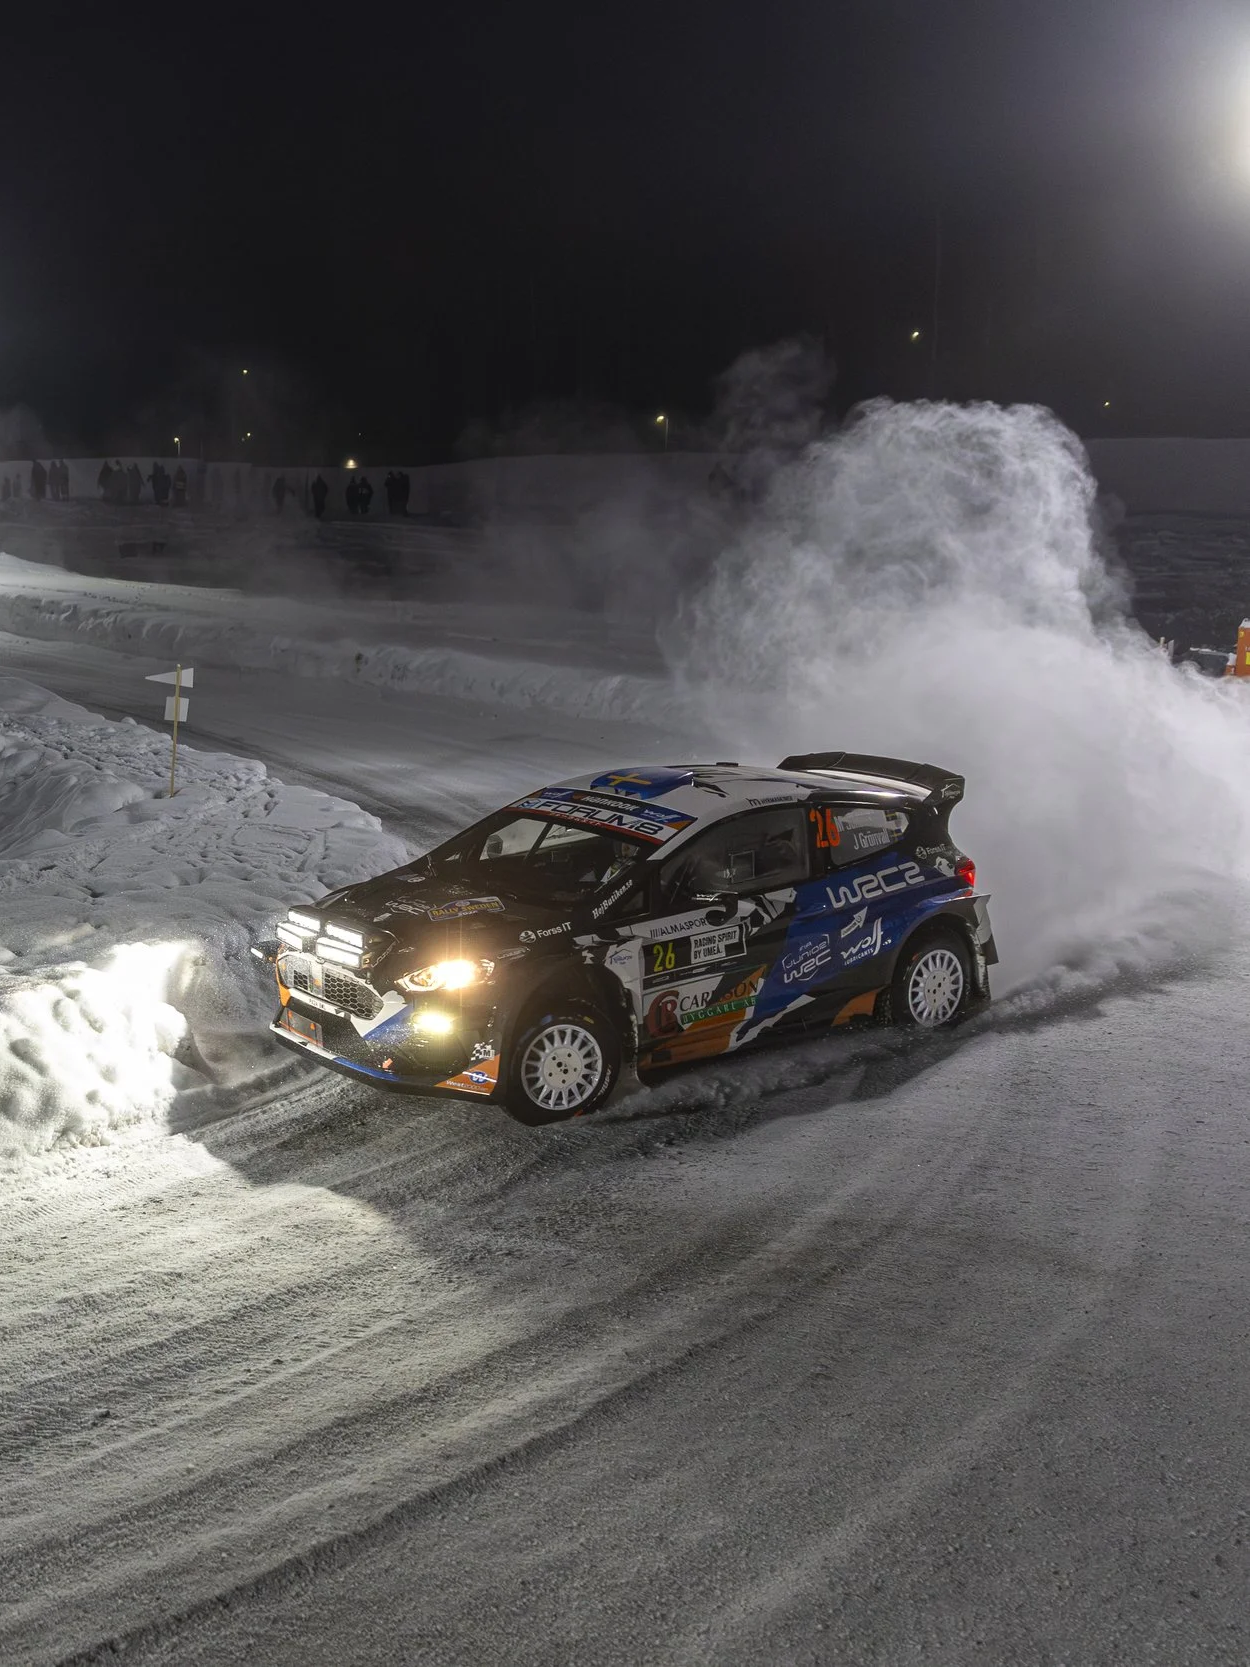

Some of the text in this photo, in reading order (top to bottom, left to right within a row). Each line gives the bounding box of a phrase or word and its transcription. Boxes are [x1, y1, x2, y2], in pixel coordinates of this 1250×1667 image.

[536, 801, 664, 835] FORUM8
[809, 808, 841, 848] 26
[826, 861, 925, 908] WRC2
[431, 901, 500, 917] RALLY SWEDEN
[536, 921, 572, 939] Forss IT
[693, 930, 737, 949] RACING SPIRIT
[653, 942, 676, 972] 26
[693, 949, 702, 960] BY
[784, 949, 832, 984] WRC
